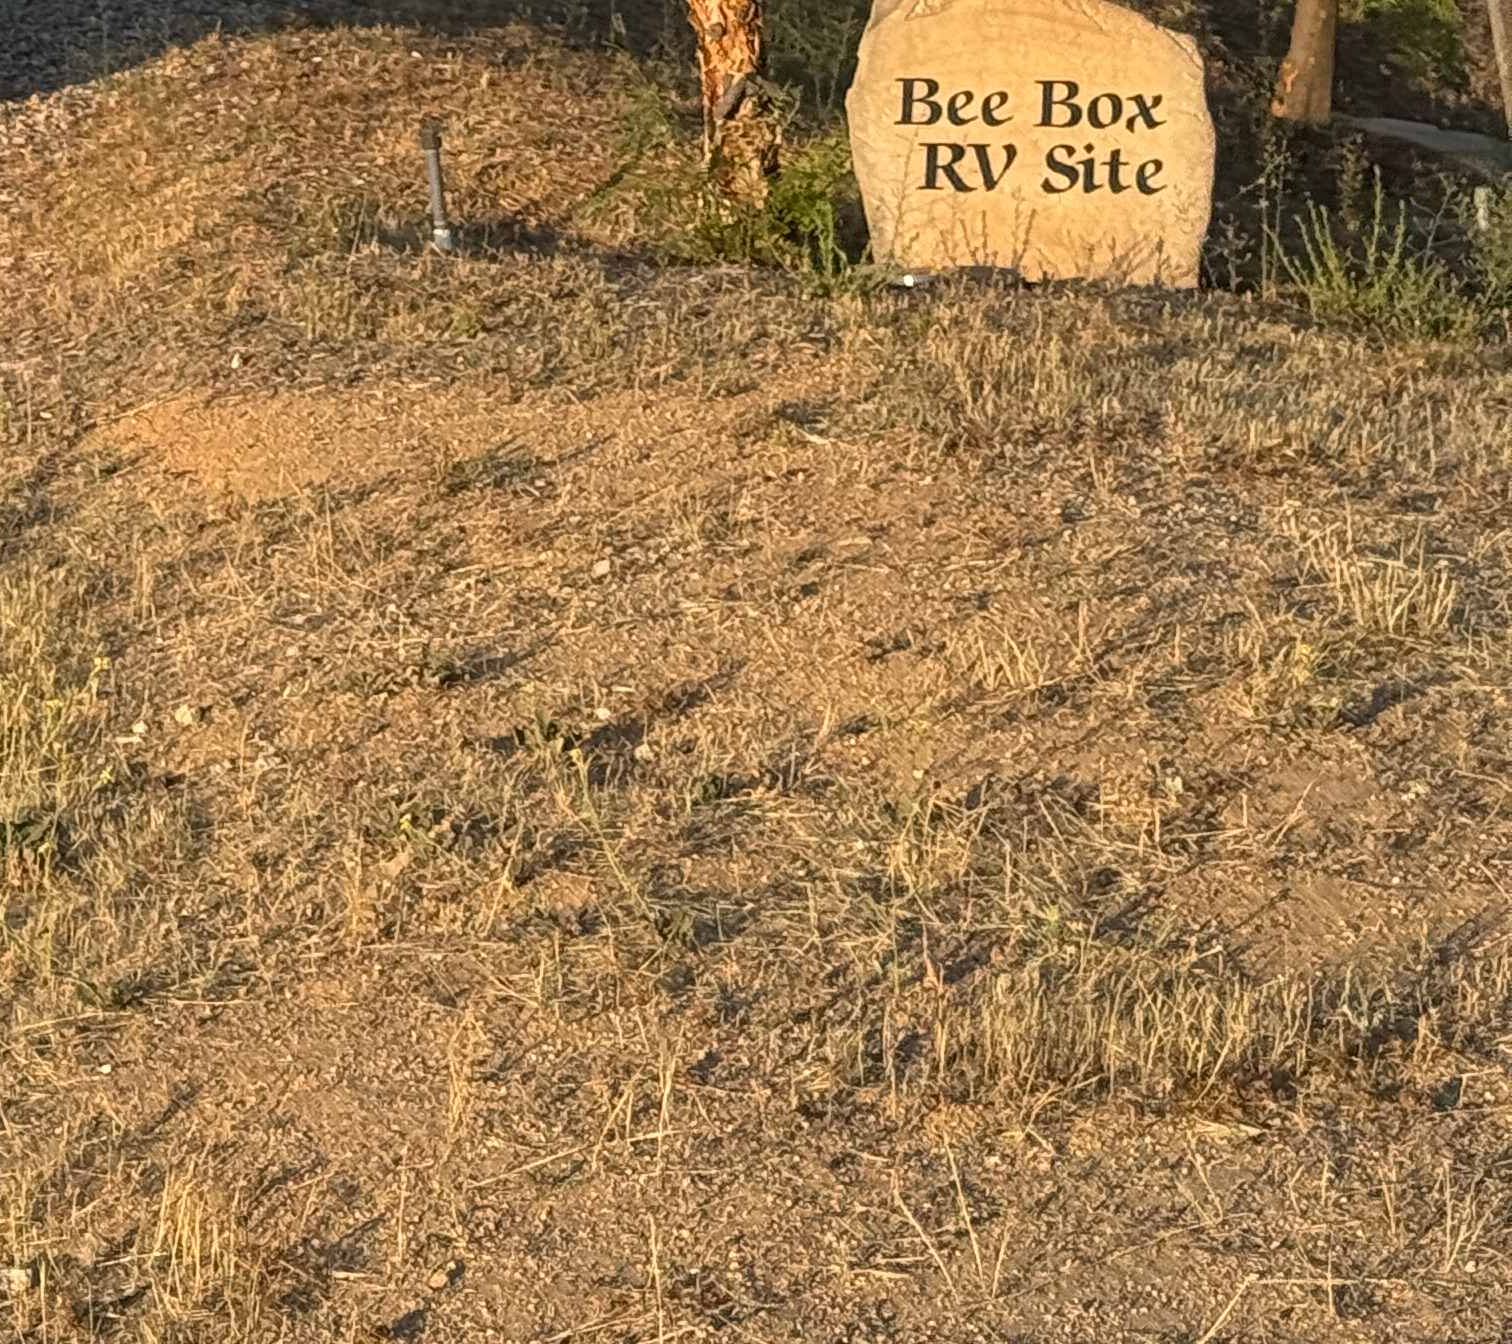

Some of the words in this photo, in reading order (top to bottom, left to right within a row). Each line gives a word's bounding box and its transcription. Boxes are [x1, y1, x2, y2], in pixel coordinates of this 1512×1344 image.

[894, 77, 1014, 127] Bee
[1034, 79, 1167, 133] Box
[917, 142, 1017, 193] RV
[1041, 143, 1168, 195] Site
